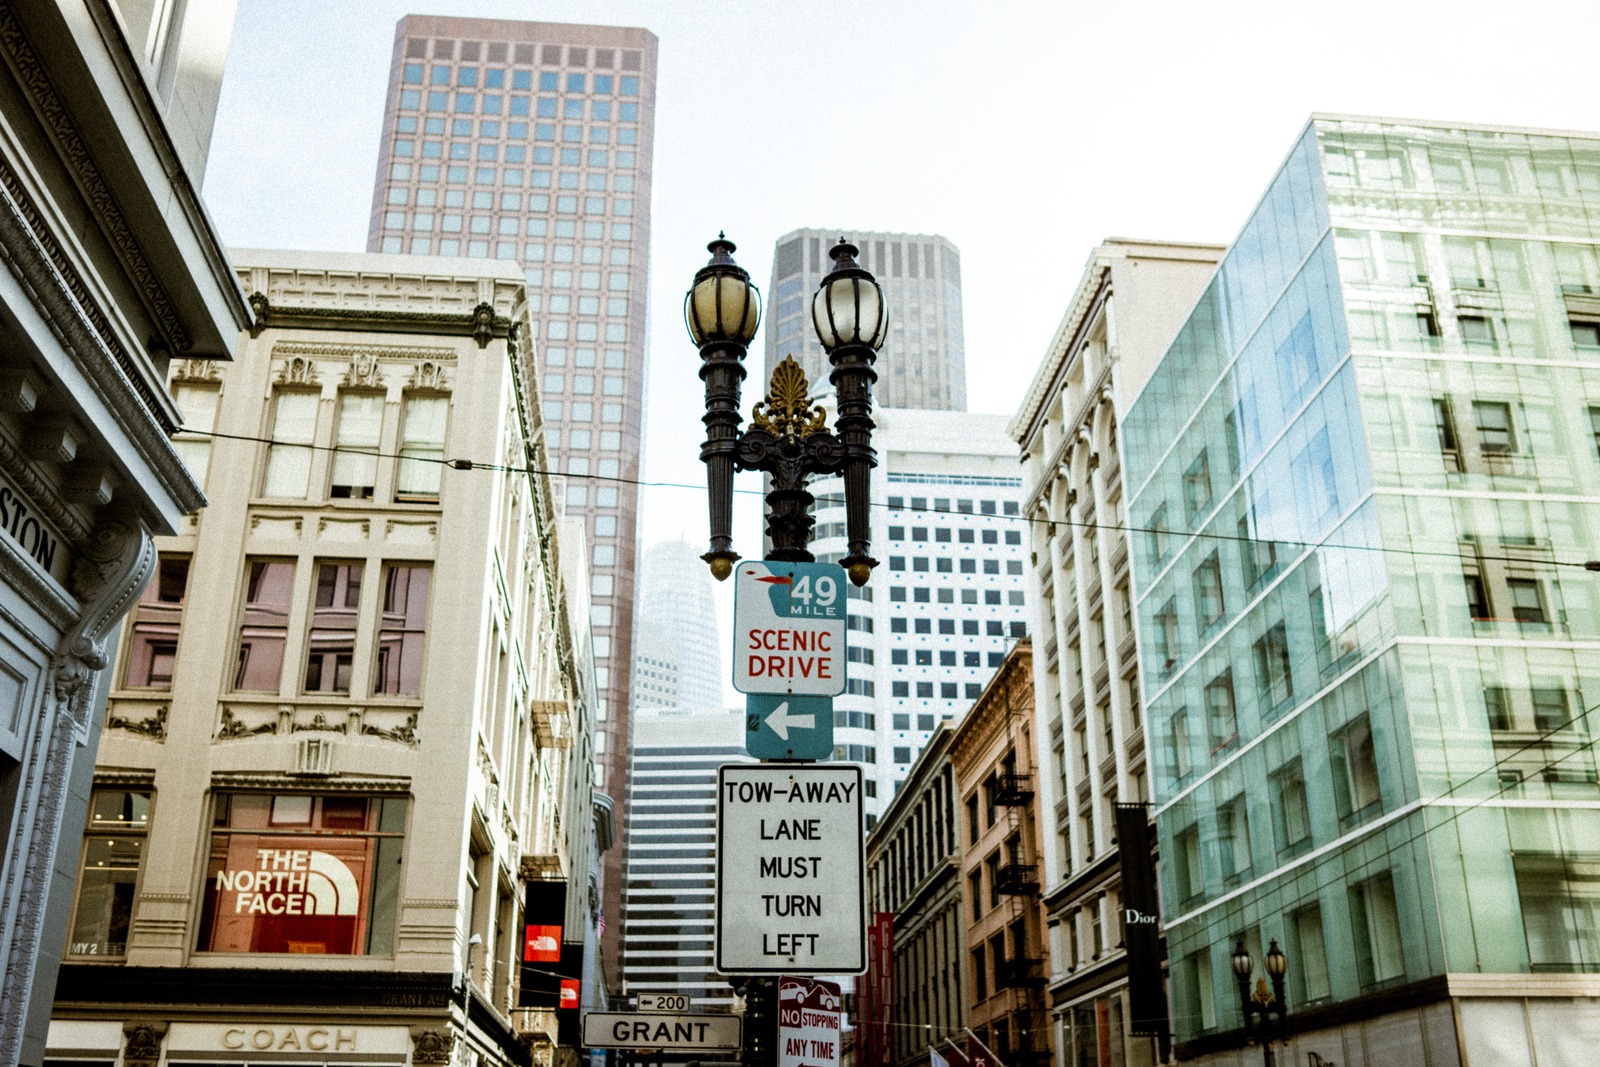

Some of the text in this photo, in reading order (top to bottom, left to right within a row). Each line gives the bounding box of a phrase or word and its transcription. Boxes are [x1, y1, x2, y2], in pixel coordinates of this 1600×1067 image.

[790, 575, 837, 606] 49
[790, 606, 837, 616] MILE
[748, 629, 831, 652] SCENIC
[748, 655, 832, 679] DRIVE
[725, 781, 857, 804] TOW-AWAY
[760, 819, 822, 840] LANE
[258, 849, 309, 871] THE
[760, 857, 822, 879] MUST
[216, 870, 306, 892] NORTH
[235, 893, 303, 915] FACE
[761, 895, 822, 917] TURN
[1125, 908, 1157, 924] Dior
[89, 943, 98, 954] 2
[763, 933, 819, 956] LEFT
[383, 993, 422, 1006] GRANT
[656, 996, 685, 1010] 200
[781, 1009, 838, 1030] NO STOPPING
[222, 1028, 357, 1051] COACH
[612, 1021, 710, 1043] GRANT
[786, 1038, 834, 1060] ANY TIME
